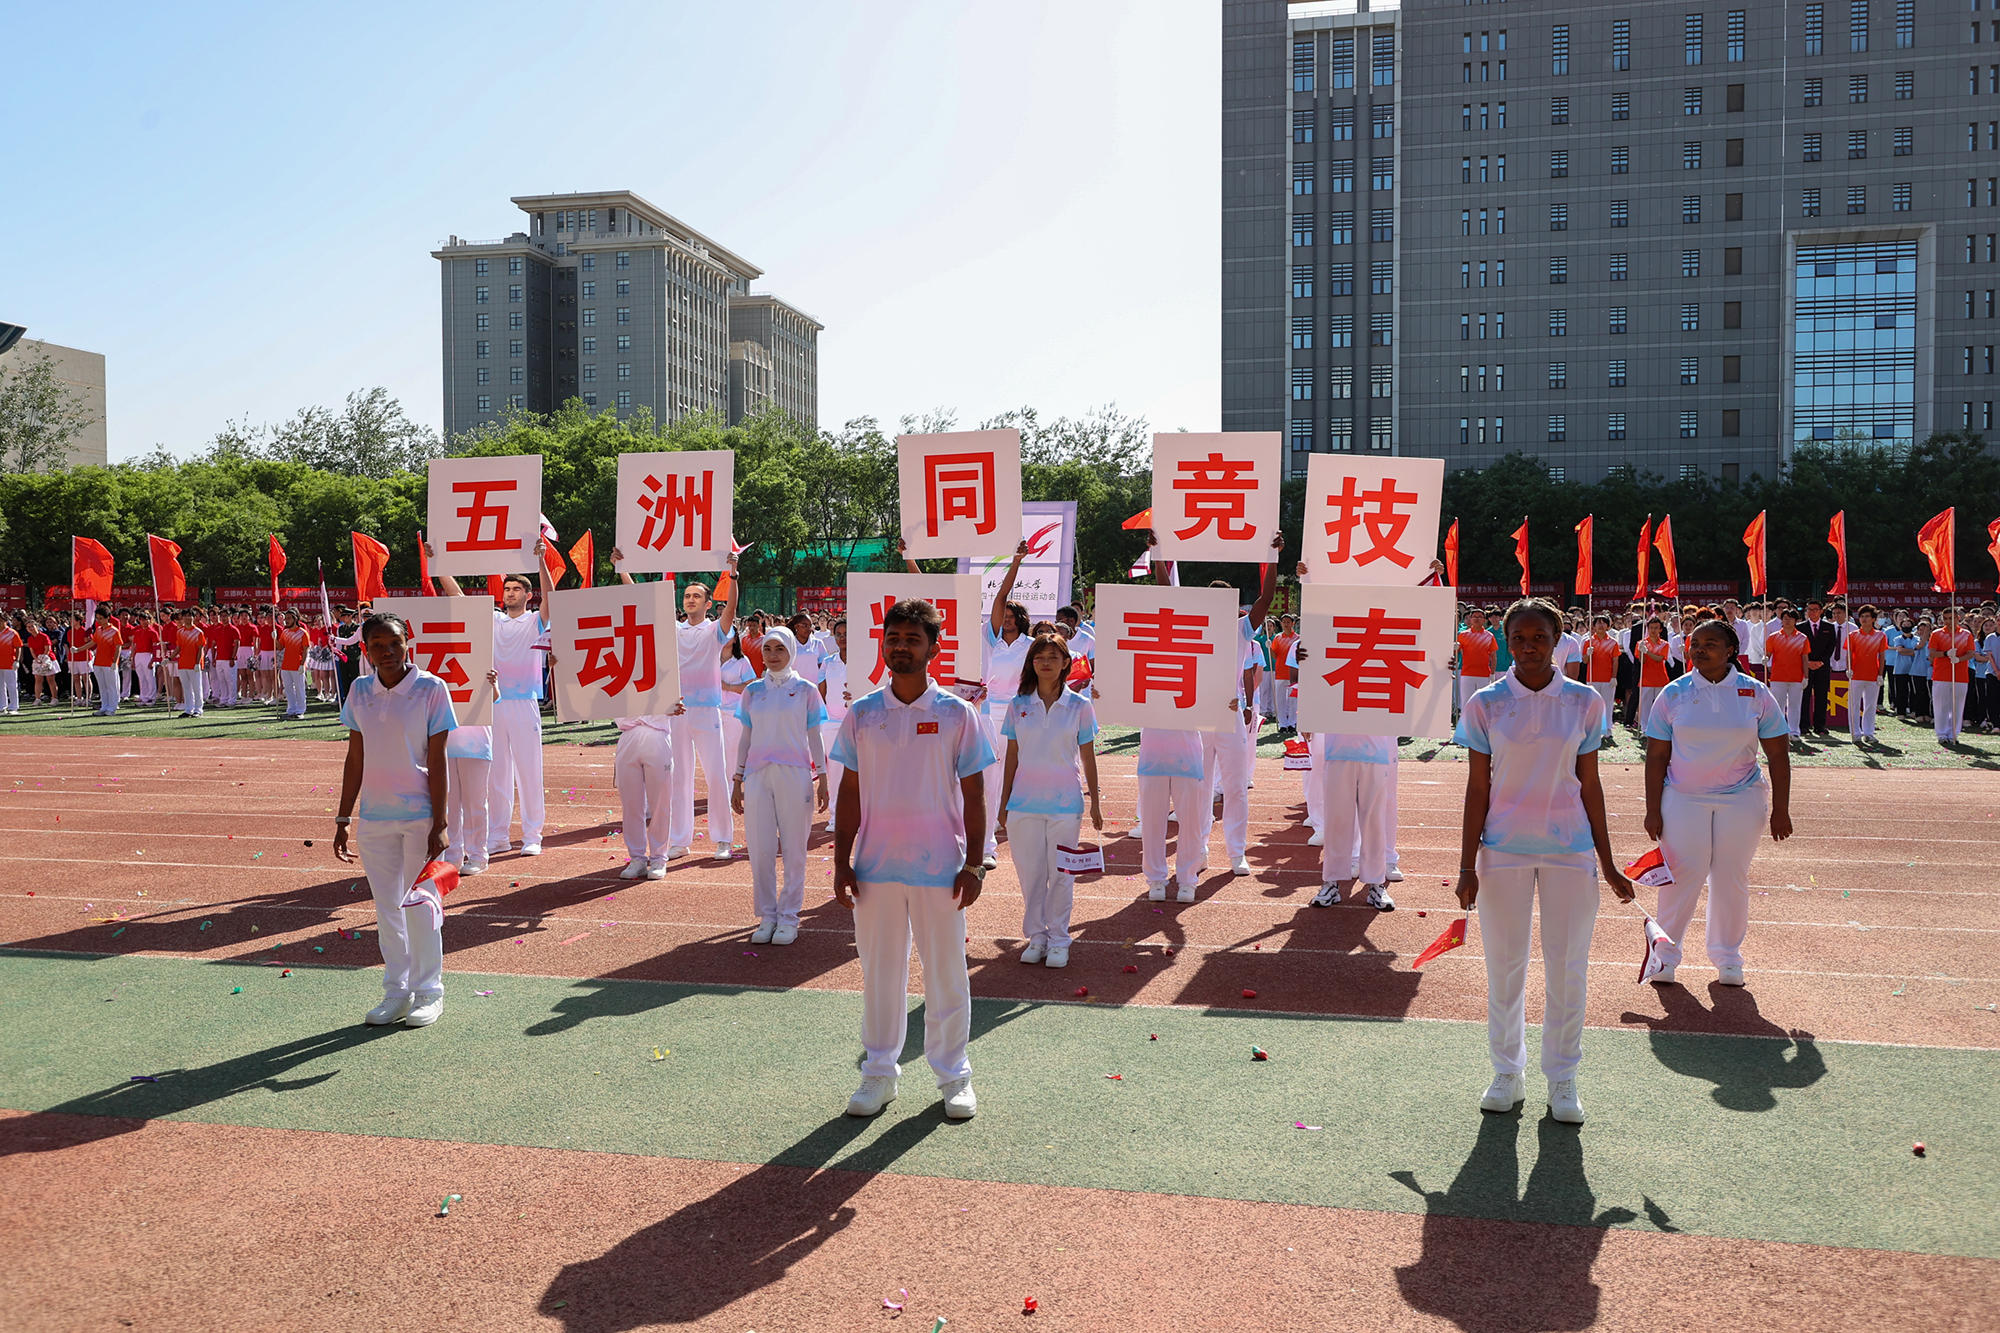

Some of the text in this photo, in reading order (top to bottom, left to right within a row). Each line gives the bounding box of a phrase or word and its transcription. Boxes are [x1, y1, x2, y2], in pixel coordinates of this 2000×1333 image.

[447, 480, 522, 551] 五
[638, 471, 713, 551] 洲
[924, 452, 996, 537] 同
[1173, 453, 1258, 540] 竞
[1325, 477, 1417, 568] 技
[406, 620, 473, 703] 运
[576, 605, 656, 697] 动
[1117, 608, 1213, 708] 青
[1323, 608, 1428, 713] 春
